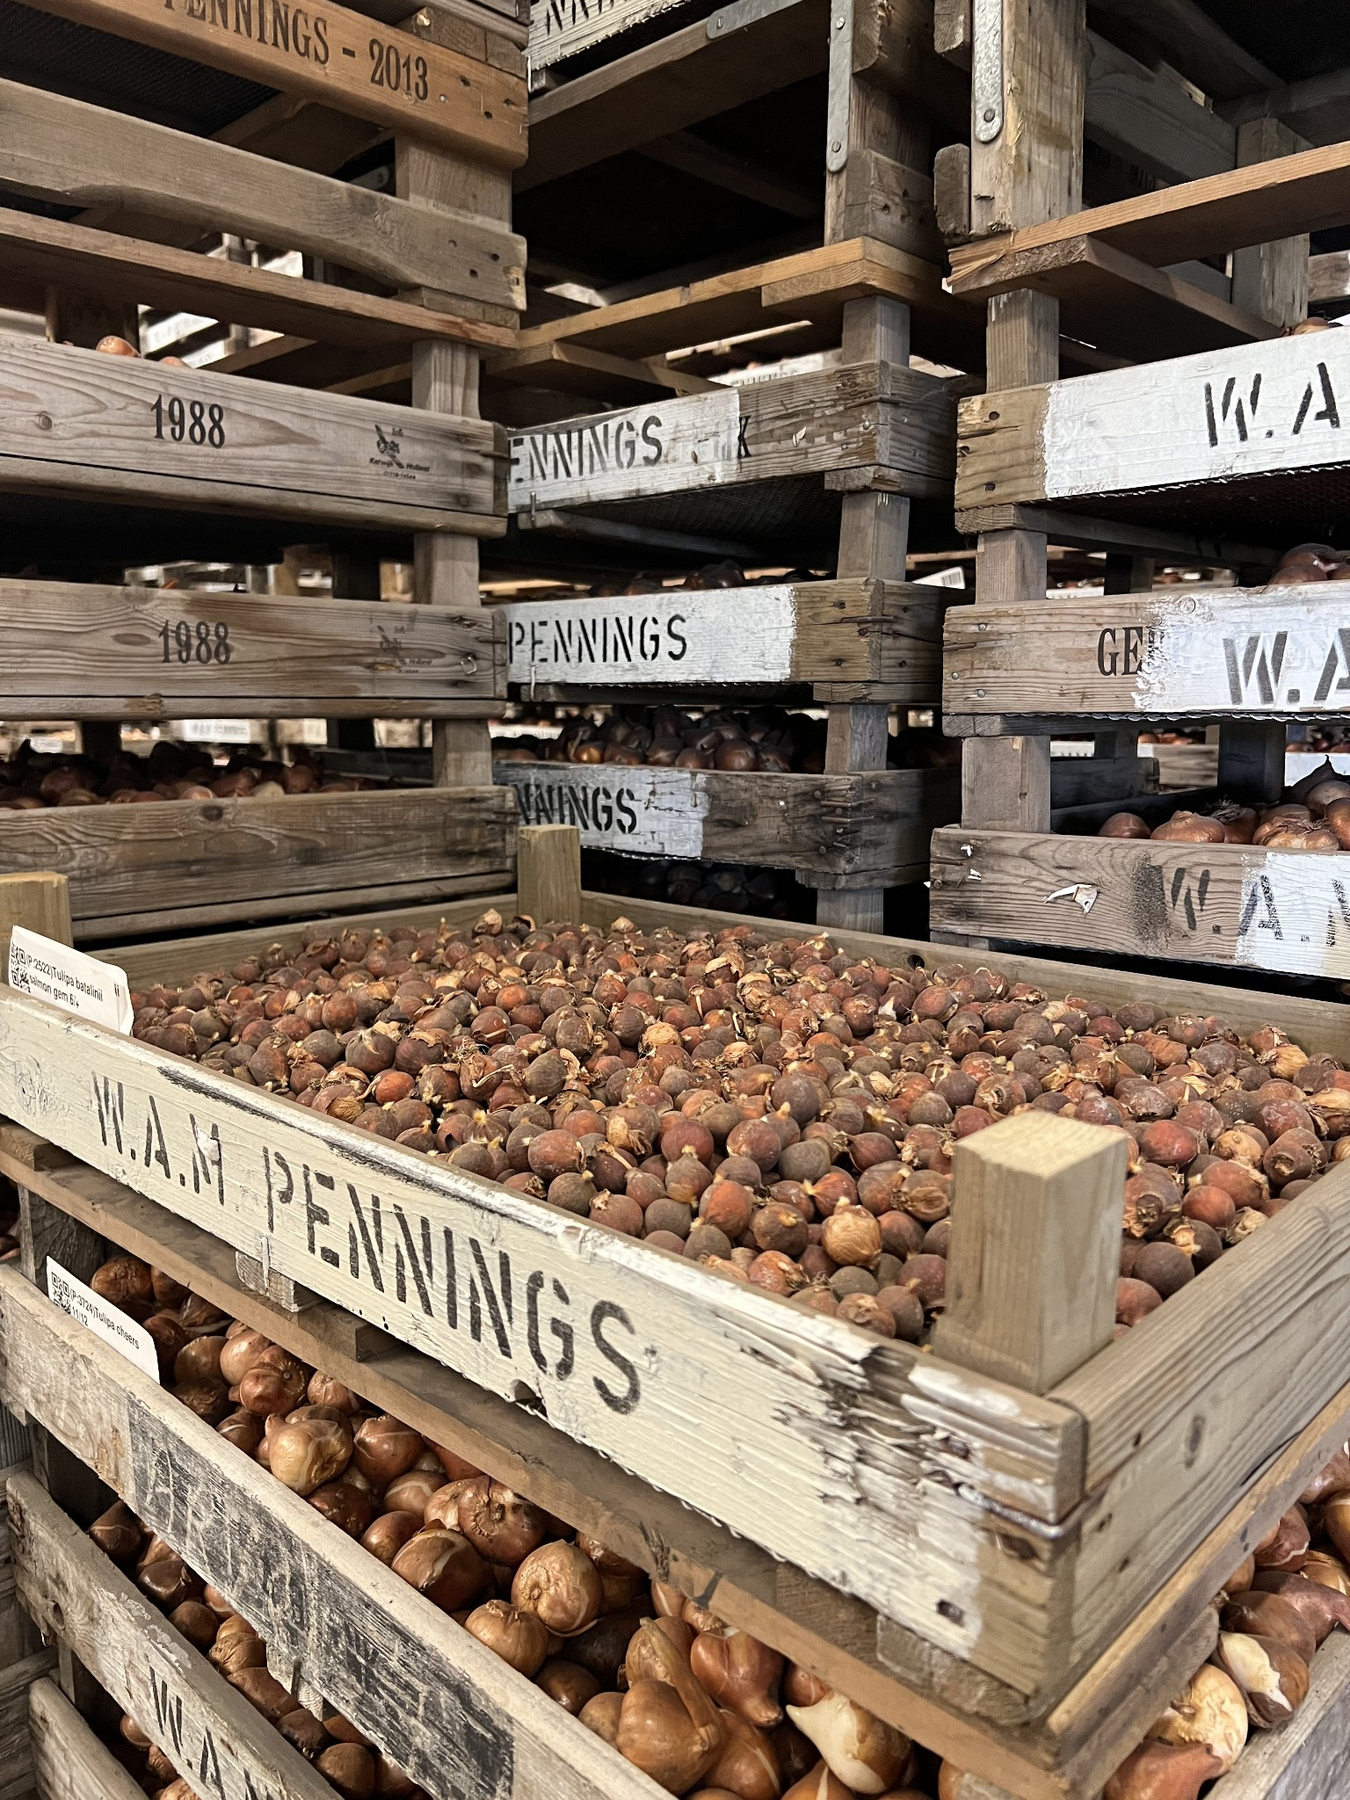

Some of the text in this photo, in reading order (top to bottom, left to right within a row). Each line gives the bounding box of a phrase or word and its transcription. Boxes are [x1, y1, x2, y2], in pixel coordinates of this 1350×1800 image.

[164, 0, 330, 65] NNINGS
[369, 38, 429, 101] 2013
[150, 393, 225, 449] 1988
[158, 620, 231, 664] 1988
[509, 613, 687, 662] PENNINGS
[53, 985, 69, 1000] gem
[262, 1145, 641, 1415] PENNINGS
[117, 1325, 139, 1350] cheers
